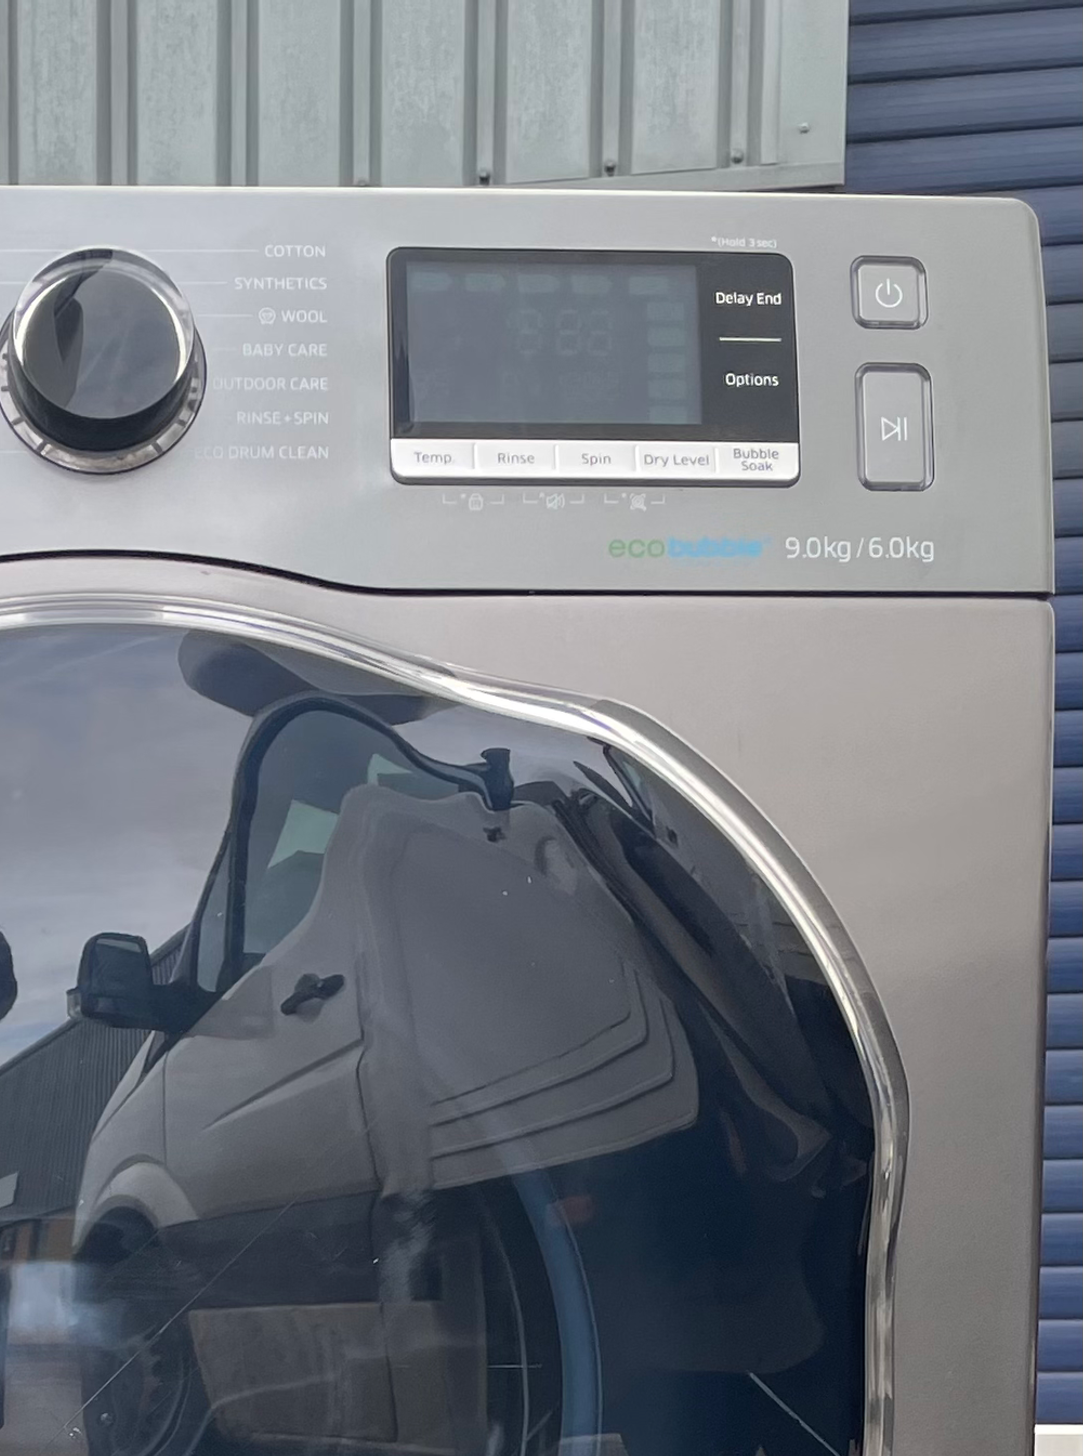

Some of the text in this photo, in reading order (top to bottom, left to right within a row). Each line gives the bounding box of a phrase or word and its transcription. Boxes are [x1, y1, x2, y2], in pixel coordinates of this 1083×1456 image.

[264, 244, 326, 258] COTTON
[234, 277, 328, 290] SYNTHETICS
[715, 291, 782, 307] Delay End
[280, 310, 328, 323] WOOL
[242, 343, 328, 357] BABY CARE
[212, 376, 329, 391] OUTDOOR CARE
[725, 372, 779, 388] Options
[228, 446, 275, 460] DRUM
[278, 446, 330, 460] CLEAN
[497, 452, 535, 464] Rinse
[581, 453, 612, 467] Spin
[733, 448, 779, 460] Bubble
[643, 454, 710, 468] Dry Level
[741, 461, 773, 472] Soak
